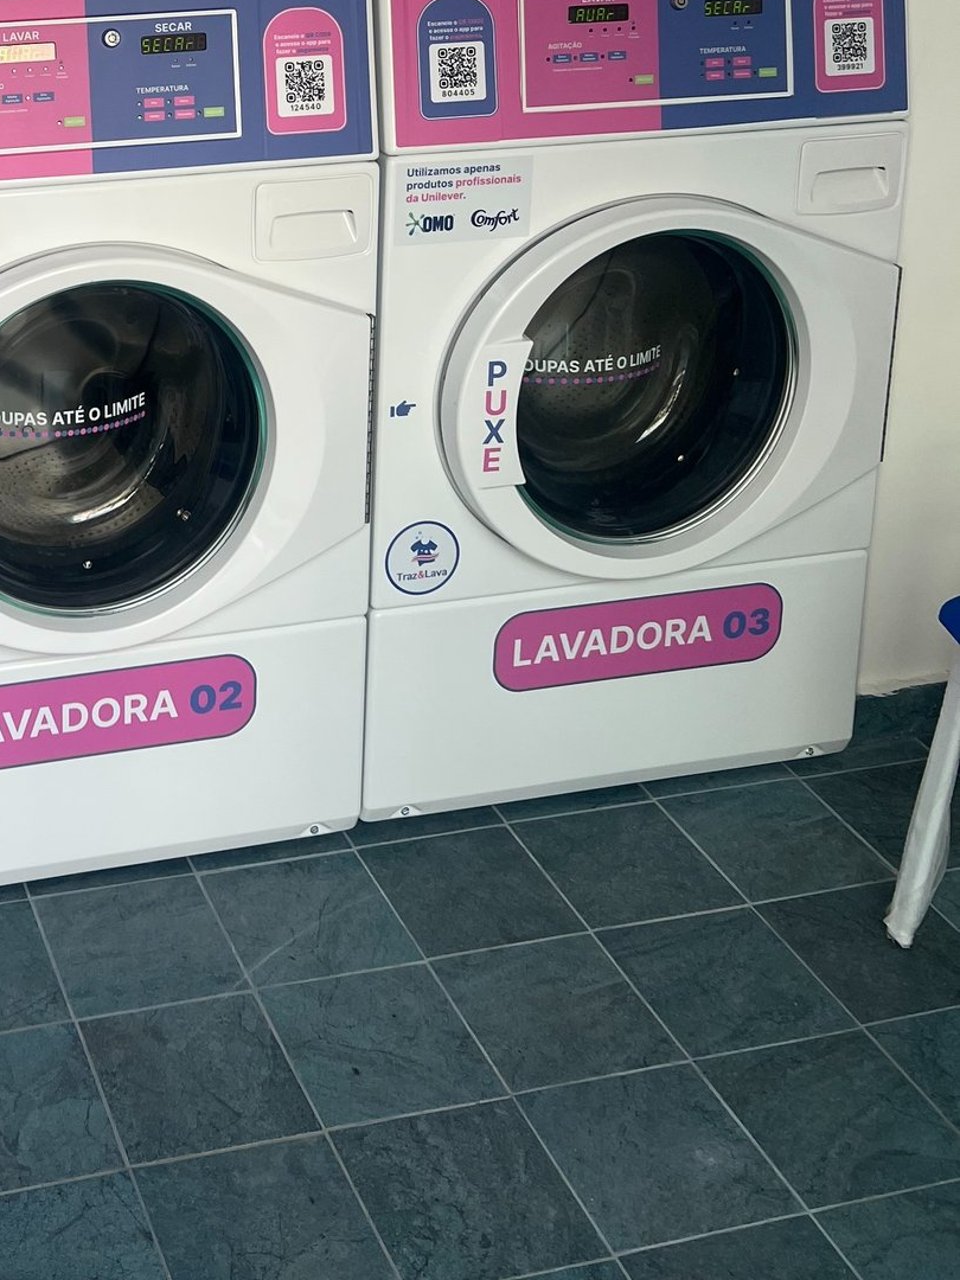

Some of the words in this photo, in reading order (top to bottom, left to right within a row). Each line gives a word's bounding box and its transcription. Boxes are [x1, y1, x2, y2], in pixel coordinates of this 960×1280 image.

[154, 21, 193, 33] SECAR
[2, 30, 40, 42] LAVAR
[699, 45, 747, 55] TEMPERATURA
[135, 83, 190, 96] TEMPERATURA
[441, 88, 475, 98] 804405
[290, 102, 322, 112] 124540
[406, 166, 462, 178] Utilizamos
[463, 164, 501, 176] apenas
[406, 179, 454, 193] produtos
[455, 173, 522, 189] profissionais
[405, 193, 419, 204] da
[421, 191, 467, 203] Unilever.
[420, 215, 453, 232] OMO
[471, 209, 519, 231] Comfort
[523, 359, 581, 374] OUPAS
[584, 355, 613, 372] ATÉ
[616, 356, 628, 370] O
[630, 345, 660, 367] LIMITE
[52, 406, 84, 425] ATÉ
[88, 406, 101, 422] O
[104, 392, 145, 420] LIMITE
[483, 361, 507, 472] PUXE
[397, 569, 448, 582] Traz&Lava
[513, 616, 711, 666] LAVADORA
[724, 608, 769, 638] 03
[190, 681, 242, 714] 02
